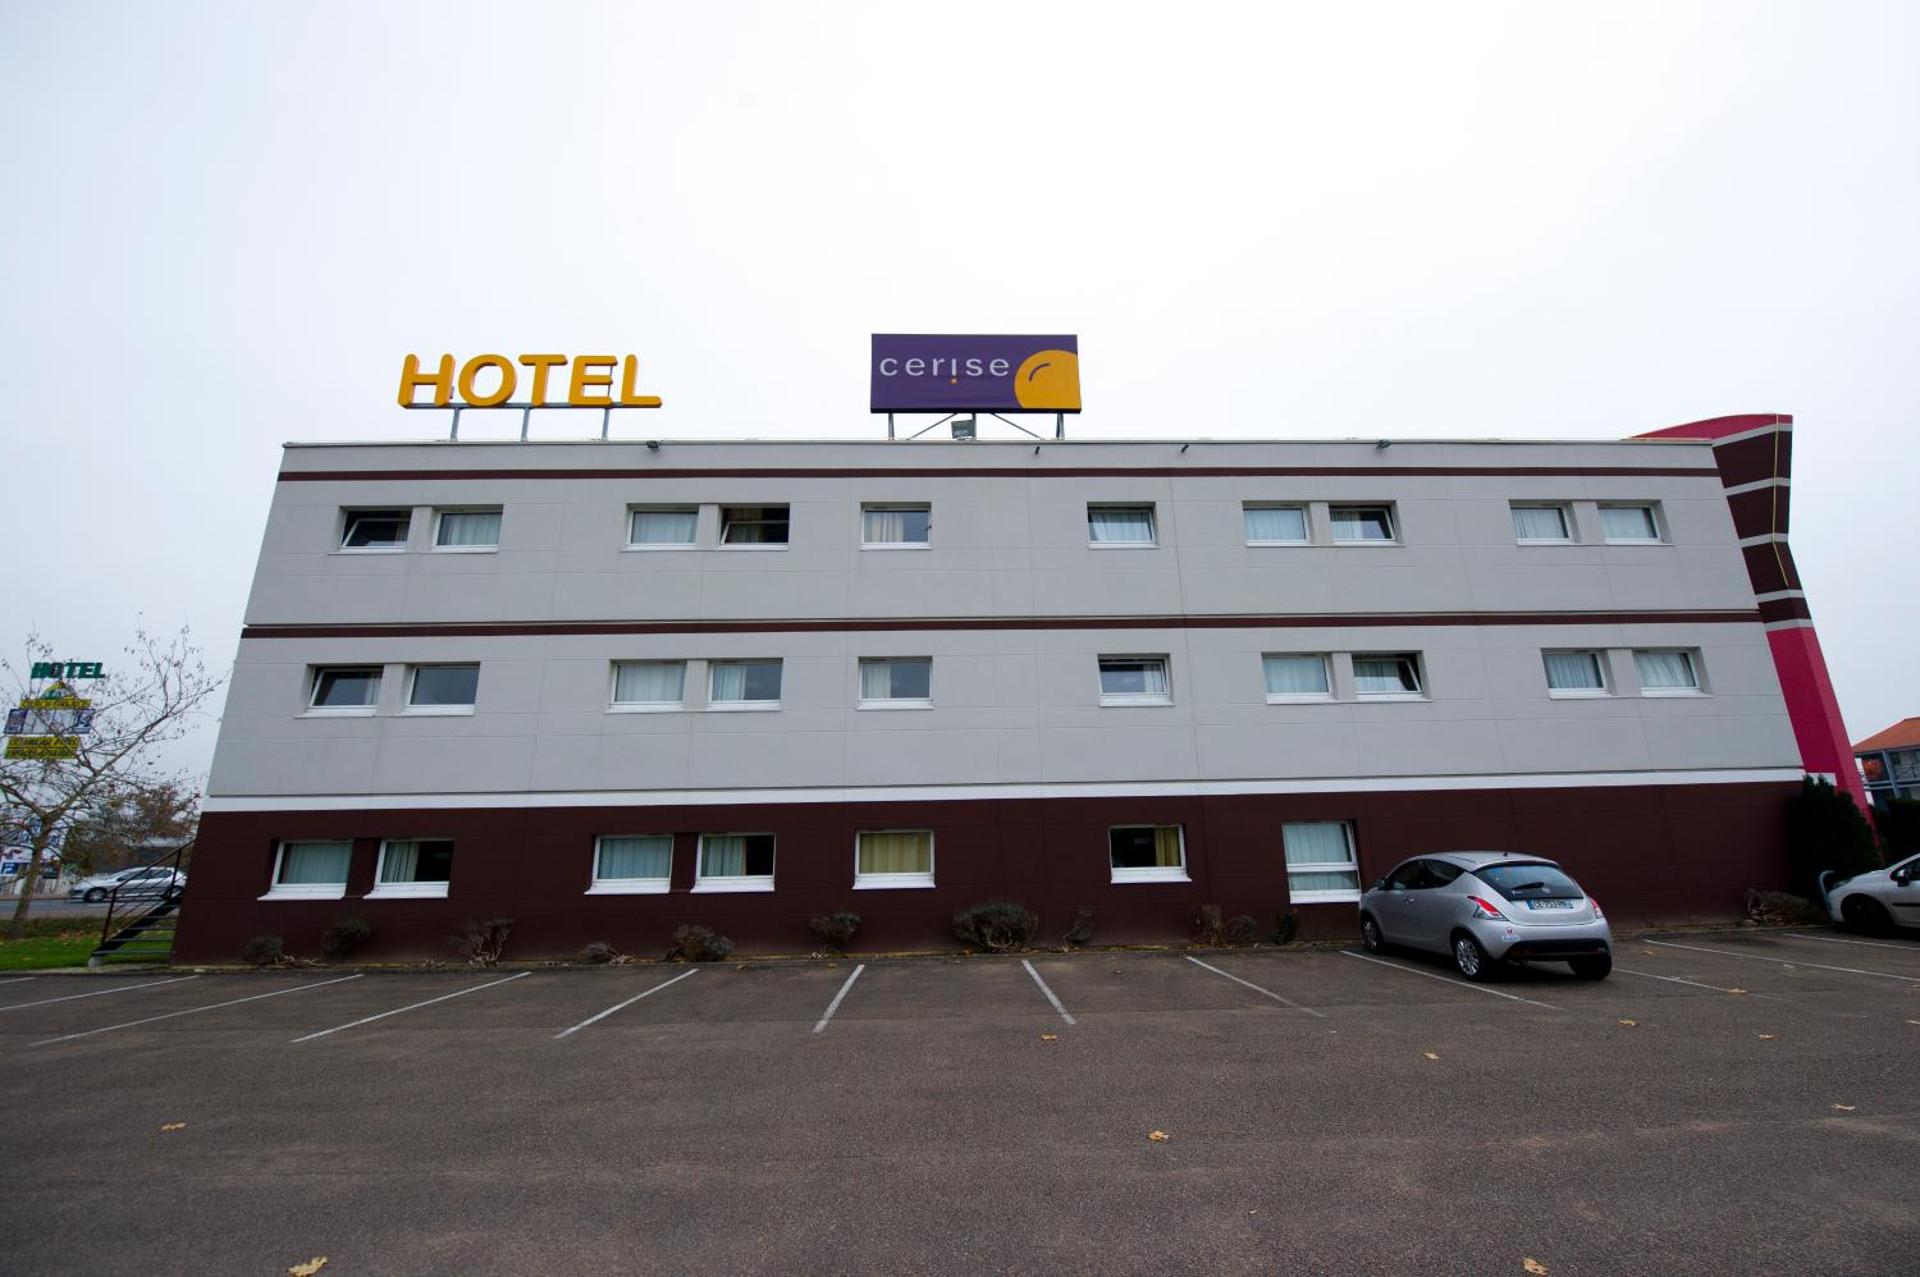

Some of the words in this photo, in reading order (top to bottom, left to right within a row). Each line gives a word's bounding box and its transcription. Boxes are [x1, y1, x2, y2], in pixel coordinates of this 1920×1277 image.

[397, 353, 663, 408] HOTEL
[879, 357, 1010, 384] cerise
[30, 662, 106, 679] HOTEL
